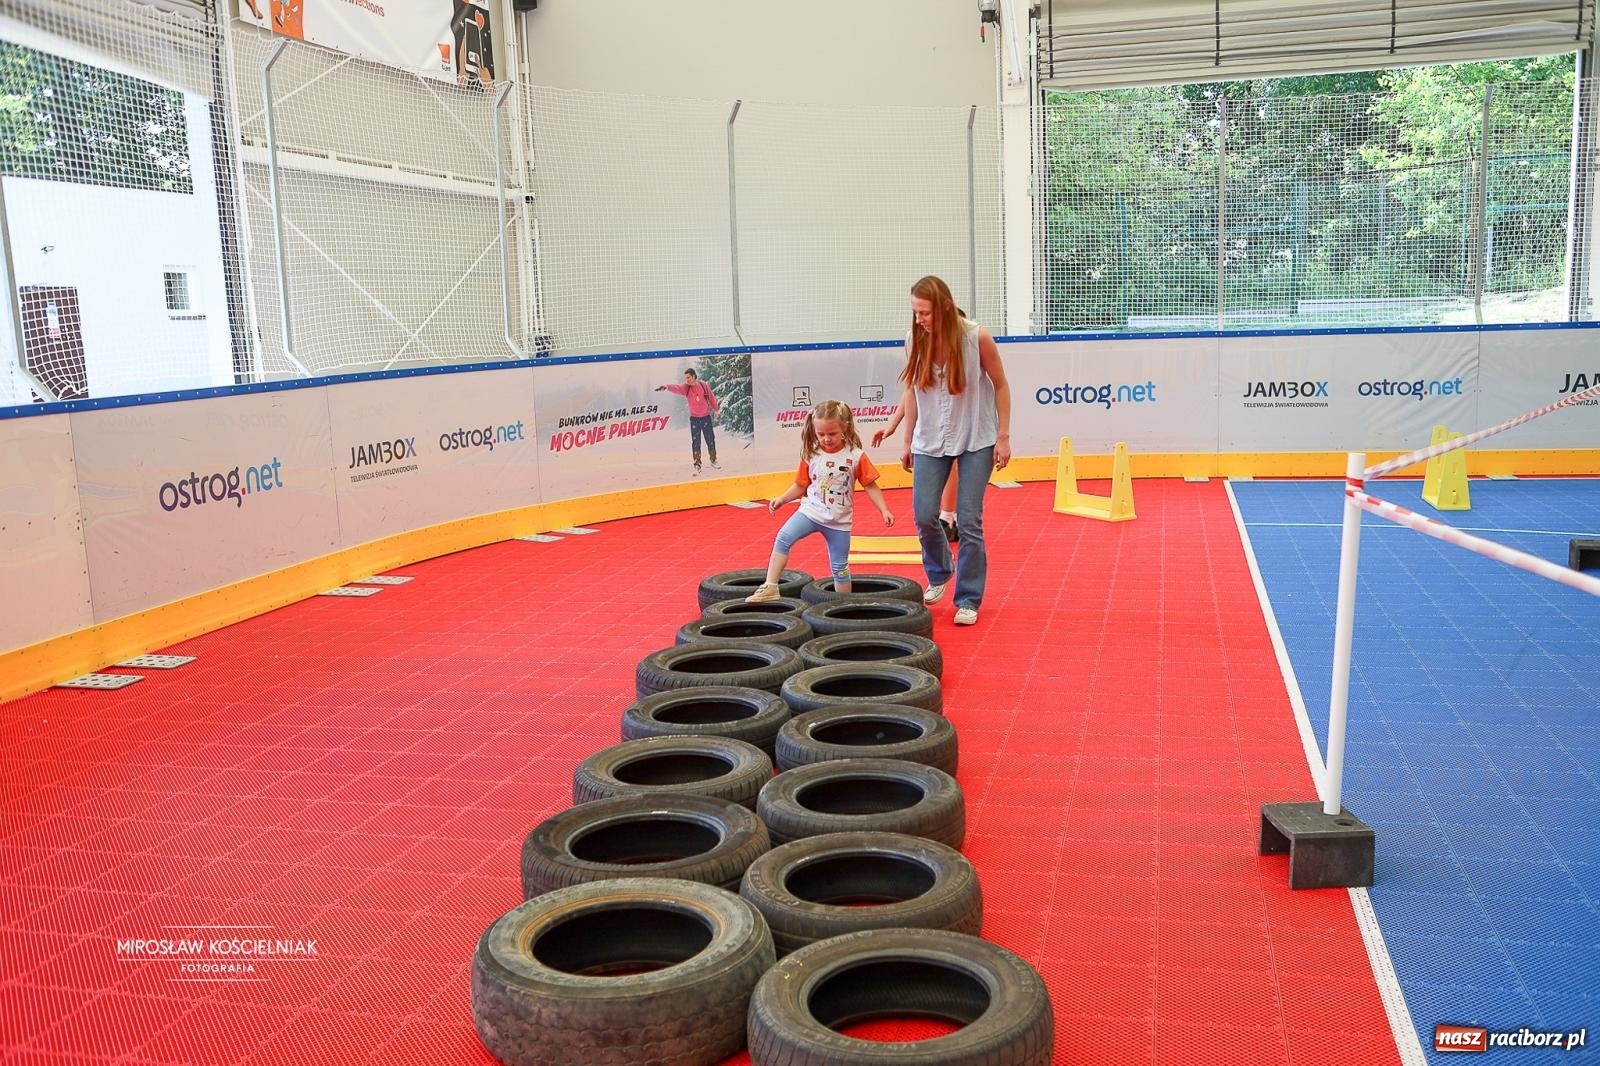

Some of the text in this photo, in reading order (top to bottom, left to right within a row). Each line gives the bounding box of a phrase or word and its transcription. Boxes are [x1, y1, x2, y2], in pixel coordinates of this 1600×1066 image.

[1035, 381, 1156, 410] ostrog.net
[1358, 378, 1462, 401] ostrog.net
[558, 412, 599, 428] BUNKRÓW
[599, 410, 614, 422] NIE
[630, 405, 646, 416] ALE
[646, 404, 658, 414] SĄ
[777, 410, 808, 422] INTER
[851, 405, 898, 417] ELEWIZJ
[439, 420, 525, 451] ostrog.net
[549, 415, 670, 452] MOCNE PAKIETY
[159, 457, 283, 511] ostrog.net
